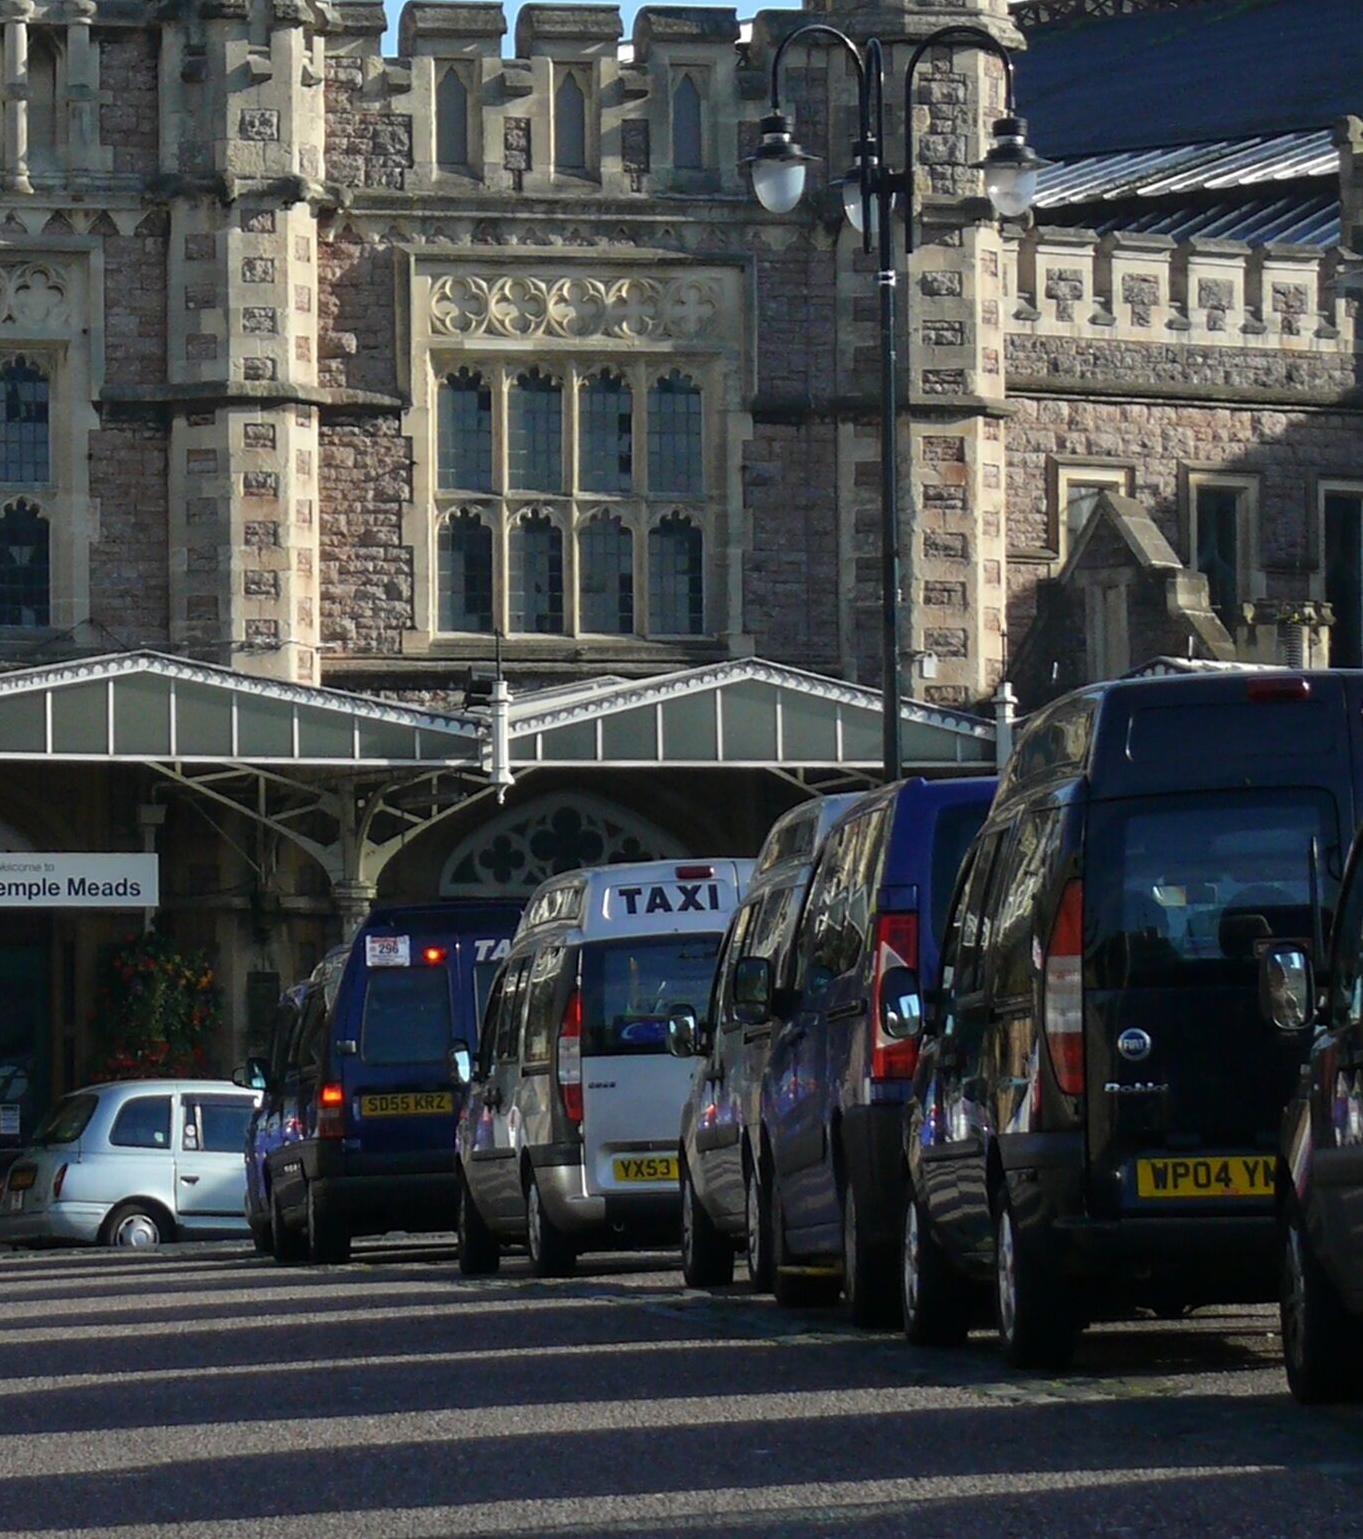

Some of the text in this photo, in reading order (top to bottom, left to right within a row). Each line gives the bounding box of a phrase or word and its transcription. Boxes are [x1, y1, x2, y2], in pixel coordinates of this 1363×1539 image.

[45, 862, 55, 872] to
[67, 877, 141, 897] Meads
[619, 883, 719, 915] TAXI
[620, 1158, 671, 1178] YX53
[1151, 1160, 1232, 1190] WP04
